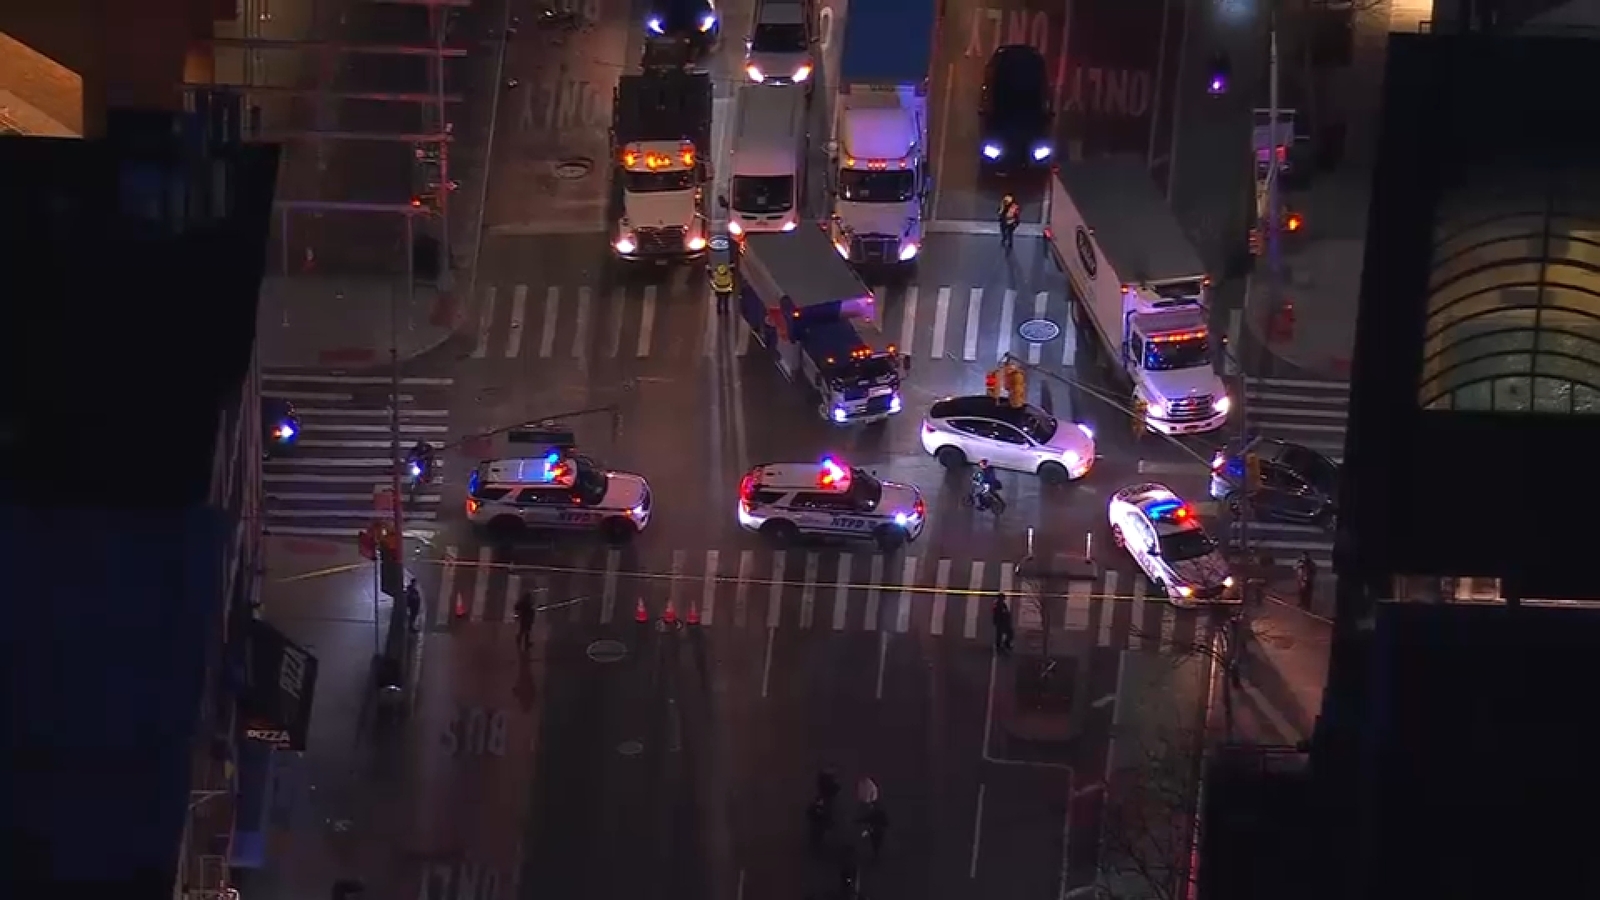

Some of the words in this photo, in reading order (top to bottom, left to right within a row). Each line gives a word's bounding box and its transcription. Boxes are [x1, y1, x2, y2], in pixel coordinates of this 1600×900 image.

[964, 8, 1049, 58] ONLY
[1063, 66, 1150, 117] ONLY
[830, 518, 865, 529] NYPD
[279, 646, 308, 700] PIZZA
[440, 706, 507, 757] BUS
